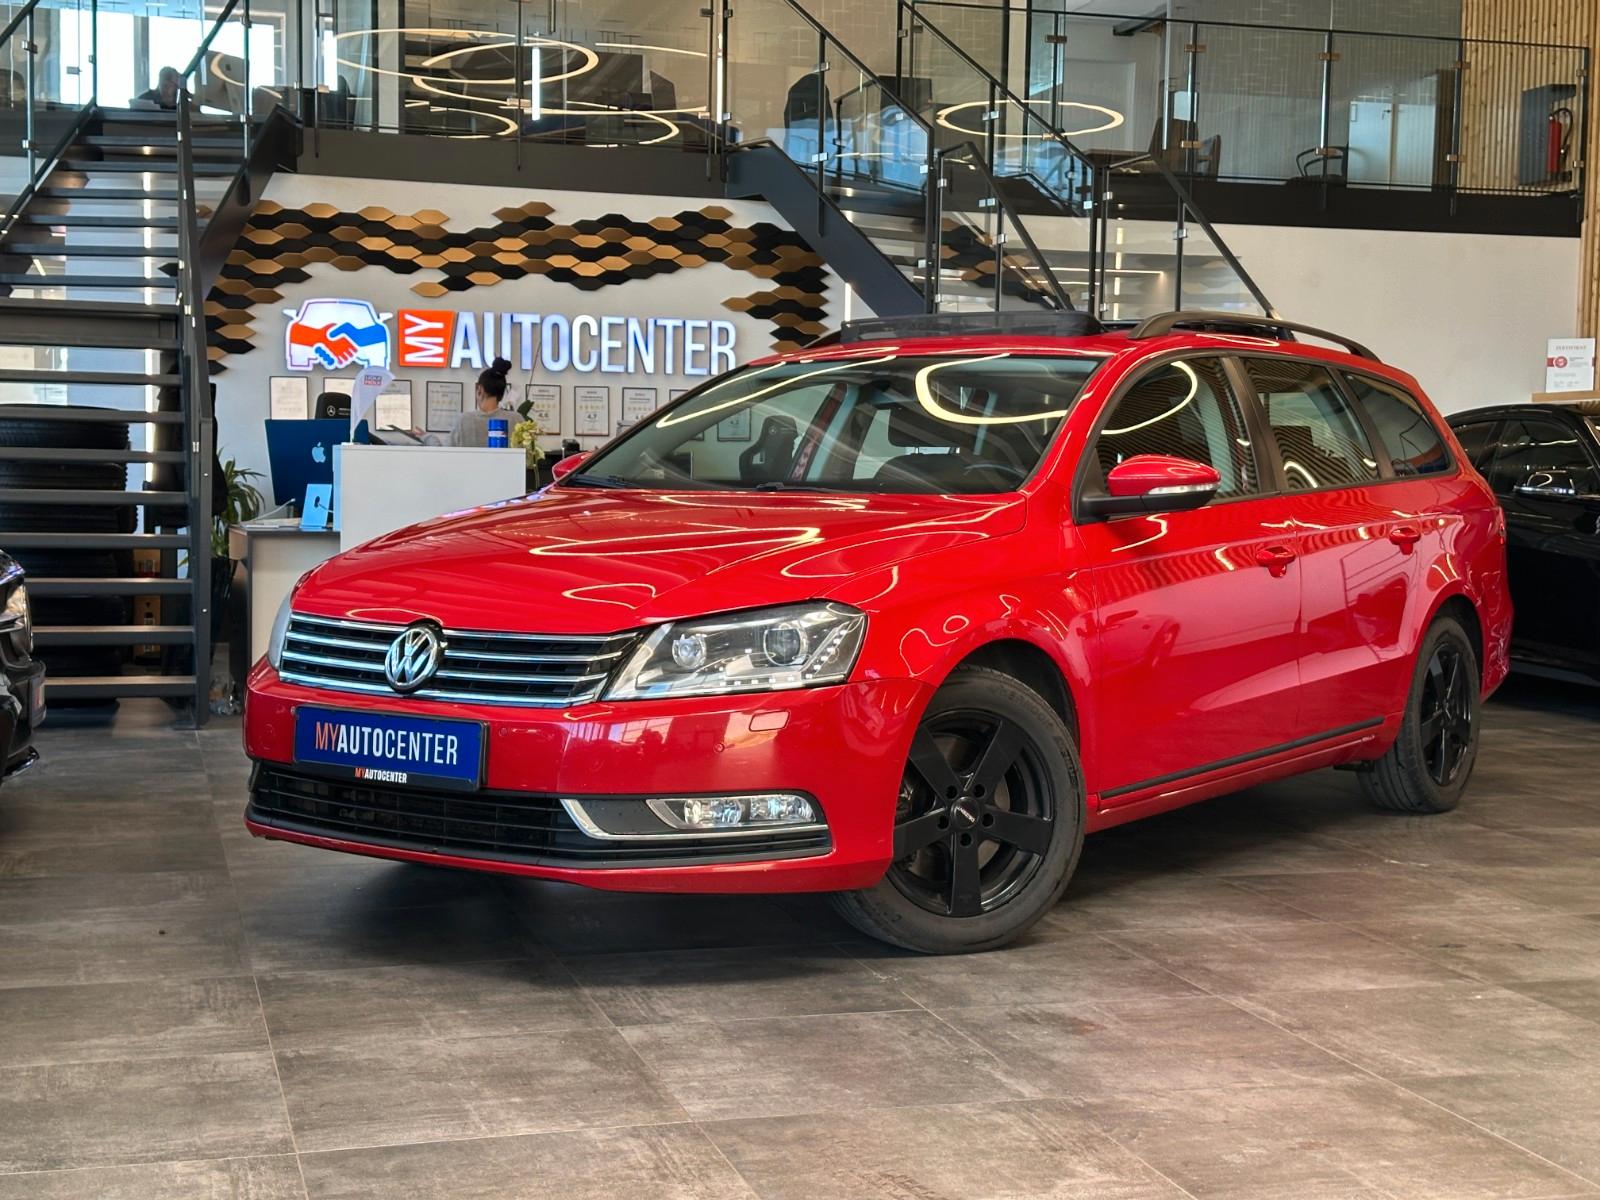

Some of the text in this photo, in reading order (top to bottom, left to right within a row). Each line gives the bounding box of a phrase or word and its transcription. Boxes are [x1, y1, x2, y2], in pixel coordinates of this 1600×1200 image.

[404, 311, 737, 376] MY AUTOCENTER
[315, 721, 457, 765] MYAUTOCENTER
[354, 767, 407, 784] MYAUTOCENTER
